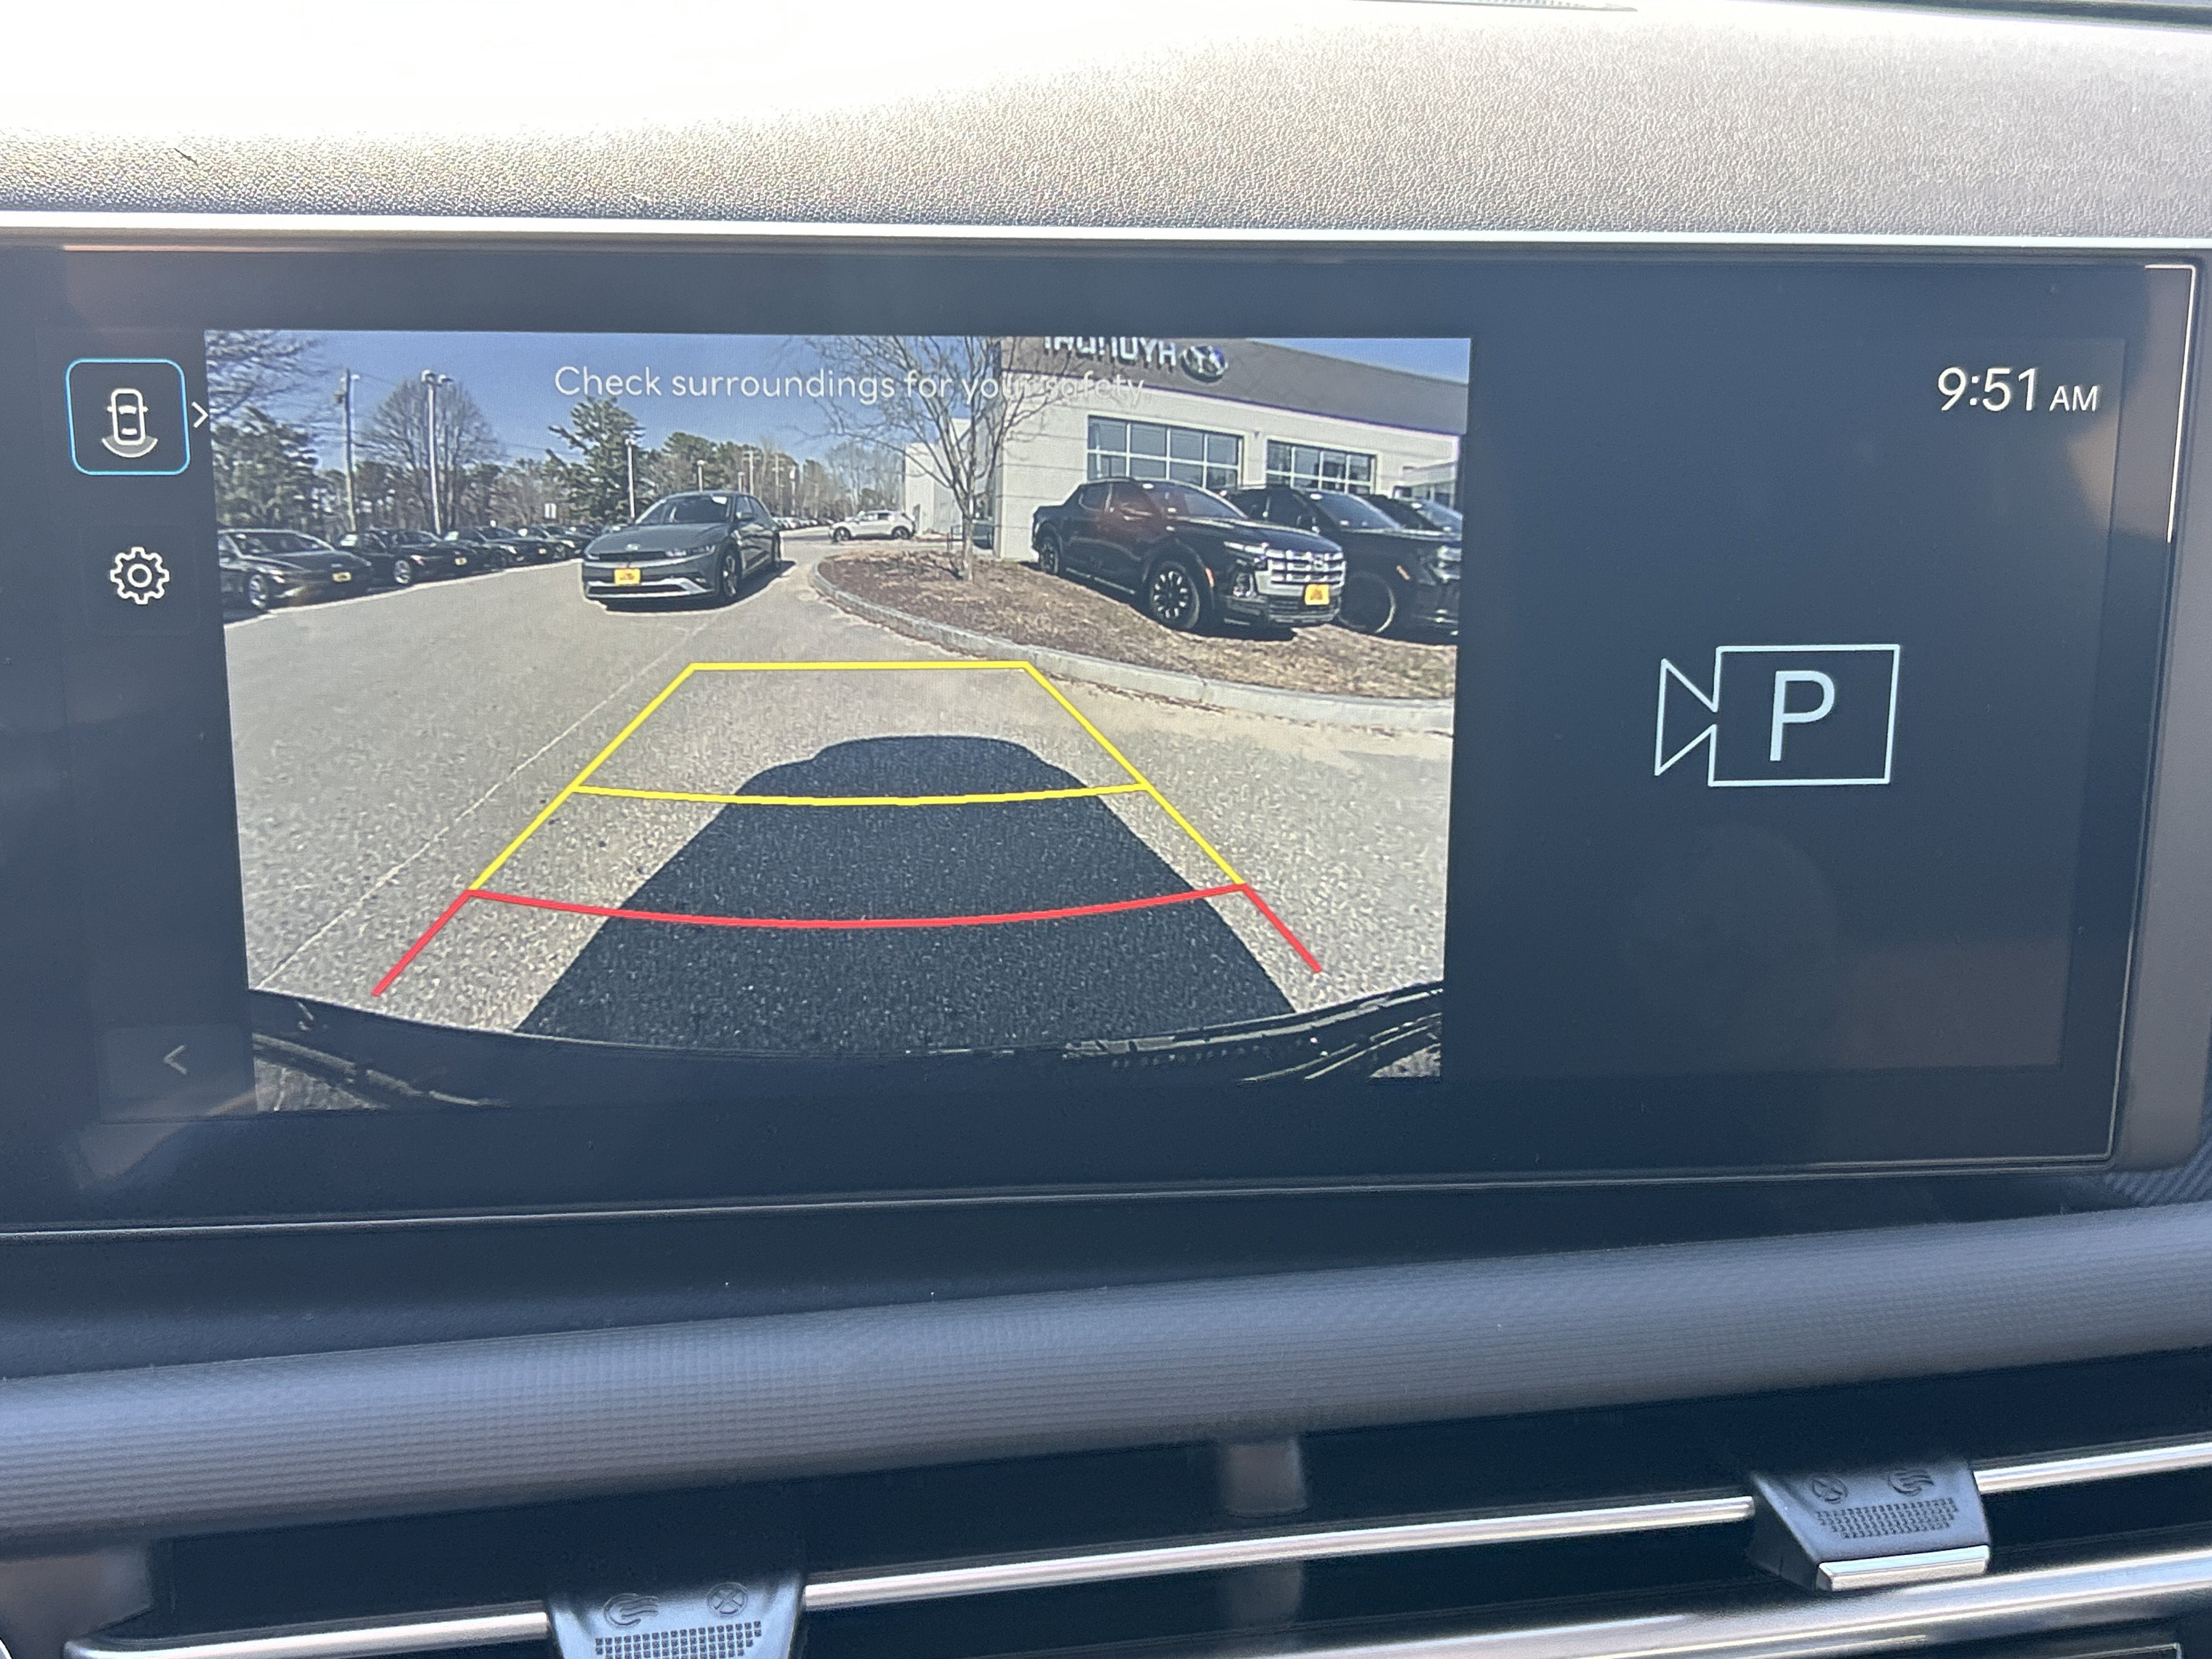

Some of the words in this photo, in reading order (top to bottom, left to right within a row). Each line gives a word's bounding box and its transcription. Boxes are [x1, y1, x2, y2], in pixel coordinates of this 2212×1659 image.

[554, 365, 662, 396] Check
[672, 368, 895, 405] surroundings
[904, 369, 953, 398] for
[961, 376, 1035, 404] your
[1938, 366, 2036, 411] 9:51
[2049, 385, 2099, 411] AM
[1770, 670, 1835, 761] P
